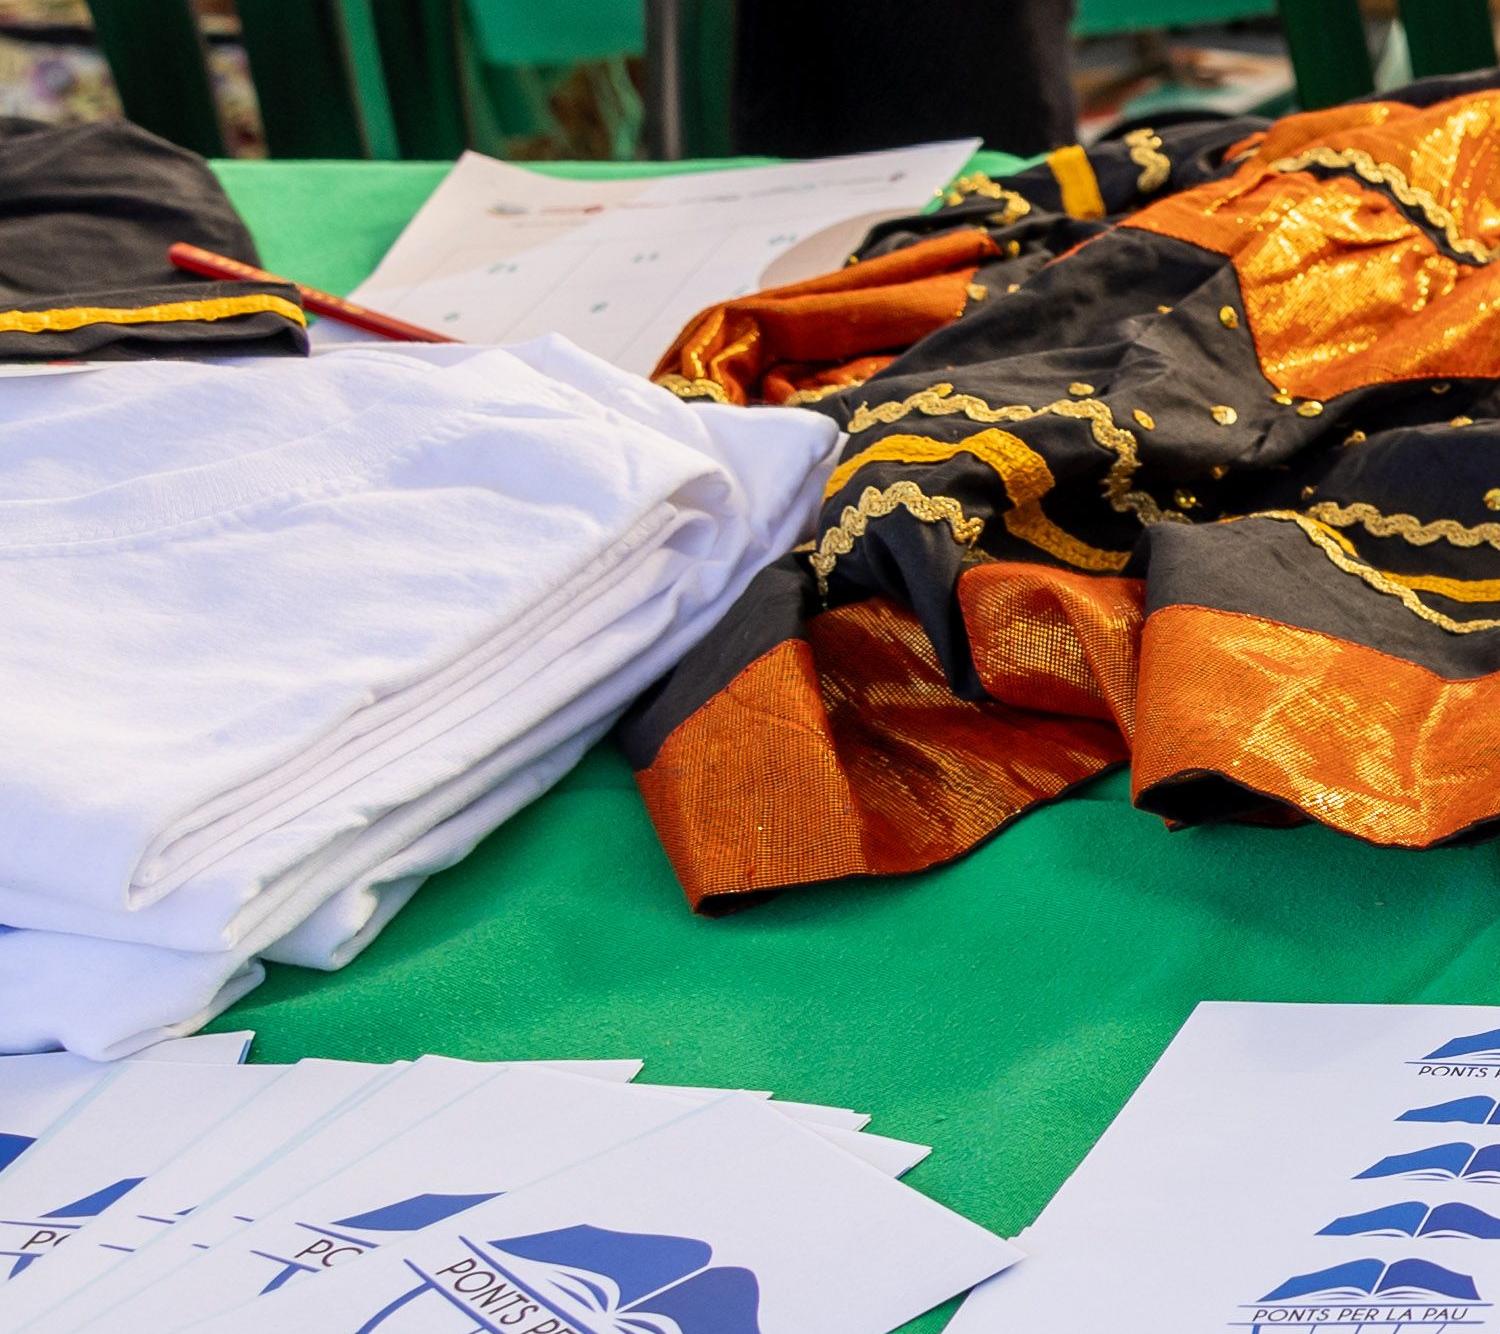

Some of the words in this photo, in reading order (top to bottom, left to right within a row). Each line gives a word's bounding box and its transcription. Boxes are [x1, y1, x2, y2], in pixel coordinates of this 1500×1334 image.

[1418, 1065, 1488, 1077] PONTS
[435, 1258, 539, 1325] PONTS
[1251, 1309, 1330, 1322] PONTS
[1337, 1308, 1379, 1321] PER
[1385, 1308, 1412, 1321] LA
[1422, 1308, 1468, 1320] PAU
